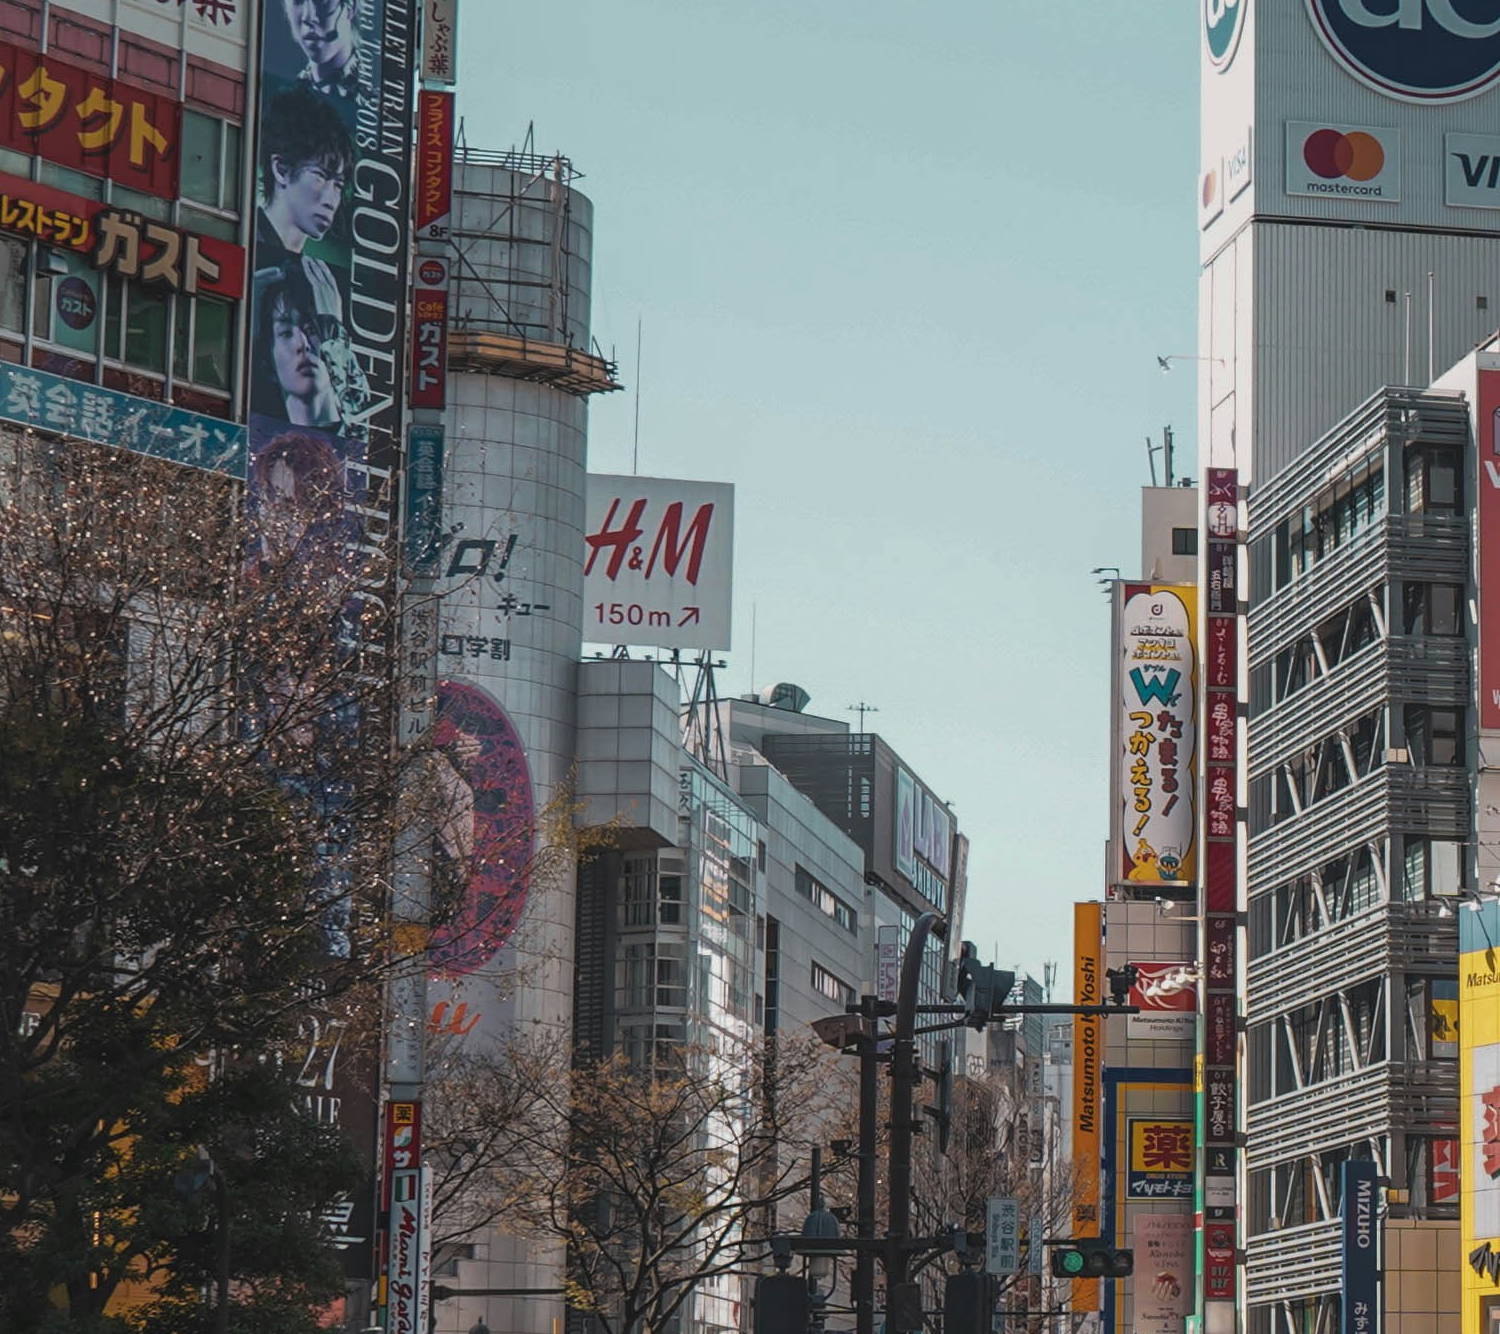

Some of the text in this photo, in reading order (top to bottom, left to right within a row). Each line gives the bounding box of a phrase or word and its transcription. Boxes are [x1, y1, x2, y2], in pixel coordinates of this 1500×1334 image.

[358, 38, 381, 91] Tour
[429, 2, 450, 75] しゃぶ葉
[356, 91, 380, 151] 2018
[382, 80, 406, 161] TRAIN
[1306, 180, 1382, 198] mastercard
[98, 210, 220, 296] ガスト
[430, 224, 448, 238] 8F
[343, 158, 402, 445] GOLDEN
[419, 322, 441, 391] ガスト
[7, 373, 241, 462] 英会話イーオン
[583, 497, 715, 586] H&M
[1129, 711, 1156, 837] つかえる!
[1157, 710, 1183, 817] たまる!
[1080, 956, 1095, 1134] Matsumoto KYoshi
[1150, 1024, 1183, 1032] Holdings
[1210, 1082, 1227, 1136] 餃子屋台
[1142, 1125, 1192, 1168] 薬
[1132, 1180, 1194, 1196] マツモトキヨ
[1355, 1180, 1372, 1250] MIZUHO
[1001, 1204, 1015, 1268] 渋谷駅前
